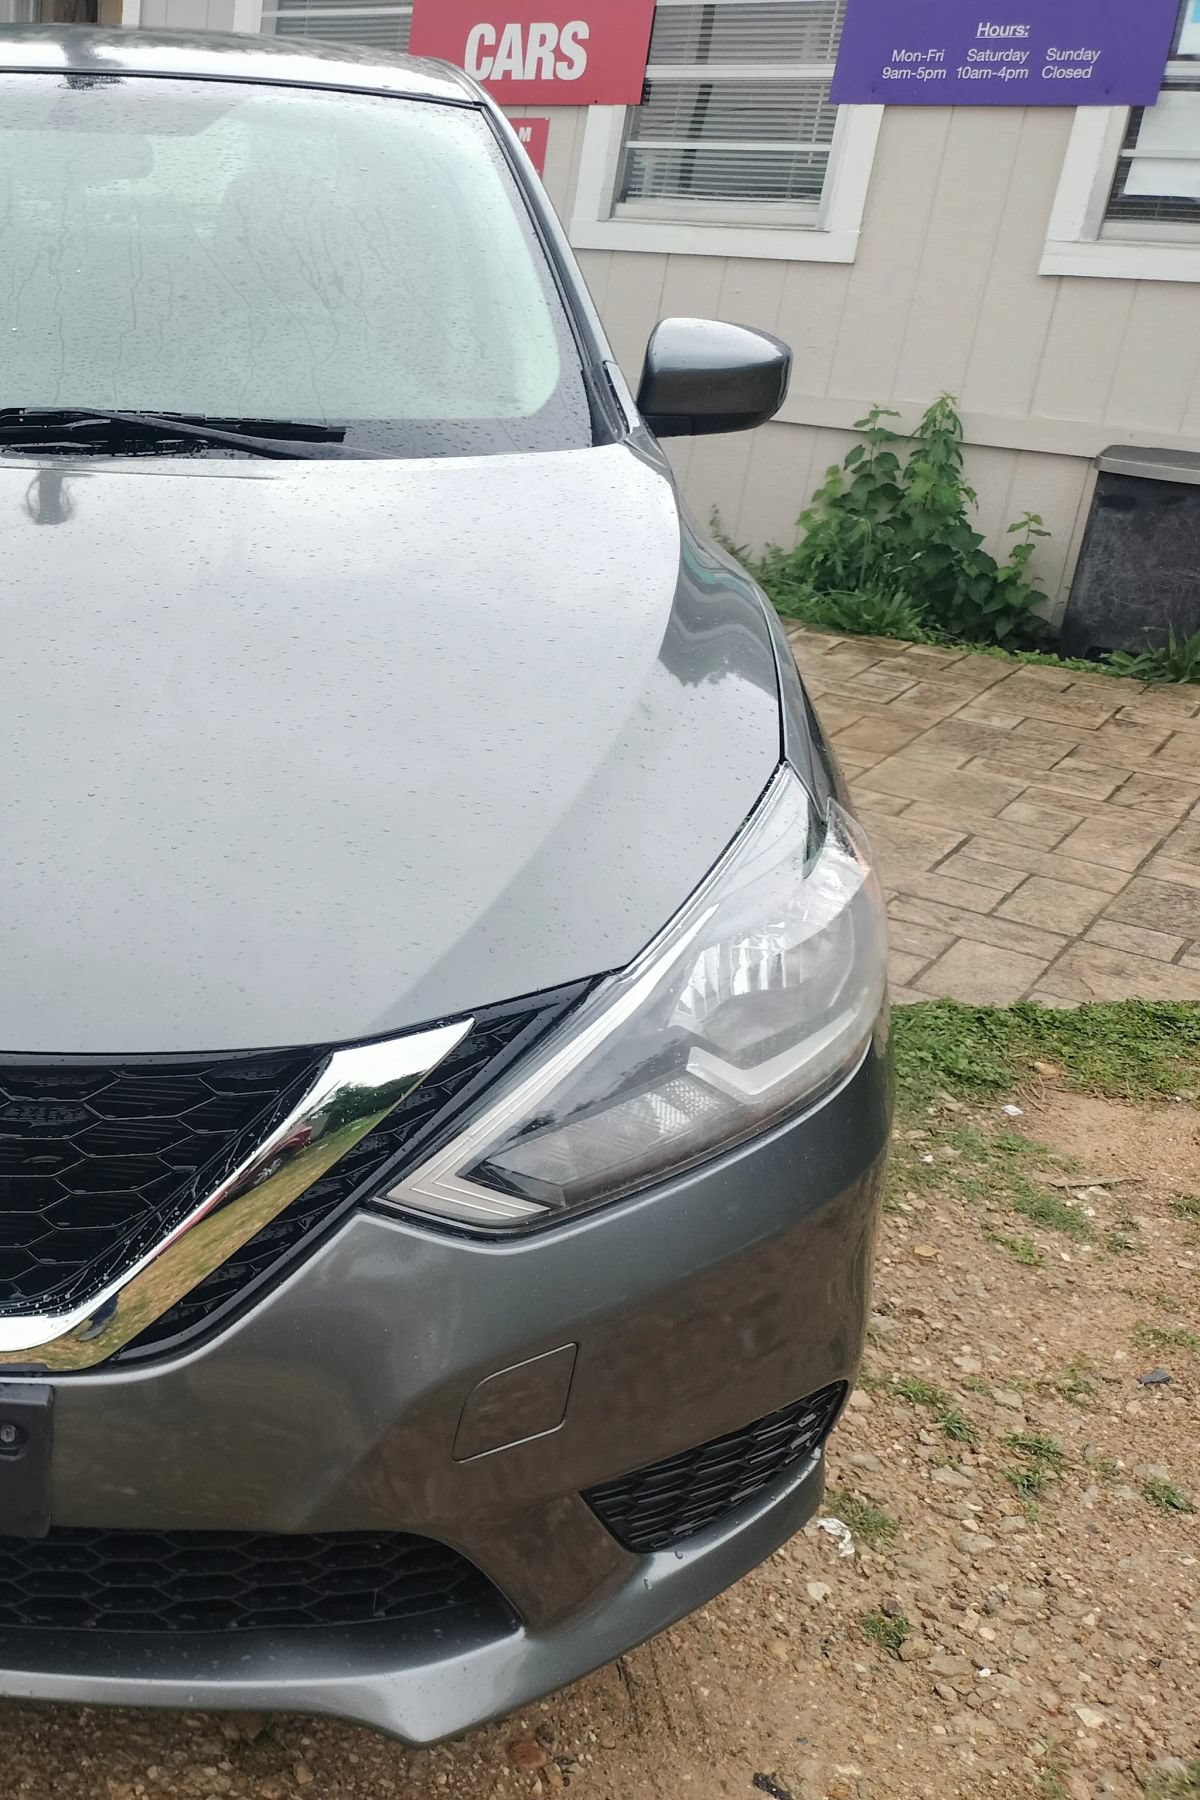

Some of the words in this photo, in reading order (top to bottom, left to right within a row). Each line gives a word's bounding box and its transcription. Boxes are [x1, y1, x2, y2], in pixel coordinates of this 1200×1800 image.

[975, 22, 1030, 38] Hours:
[464, 20, 590, 81] CARS
[891, 49, 945, 62] Mon-Fri
[966, 48, 1030, 64] Saturday
[1045, 47, 1101, 64] Sunday
[881, 66, 947, 81] 9am-5pm
[955, 66, 1029, 81] 10am-4pm
[1041, 65, 1093, 79] Closed
